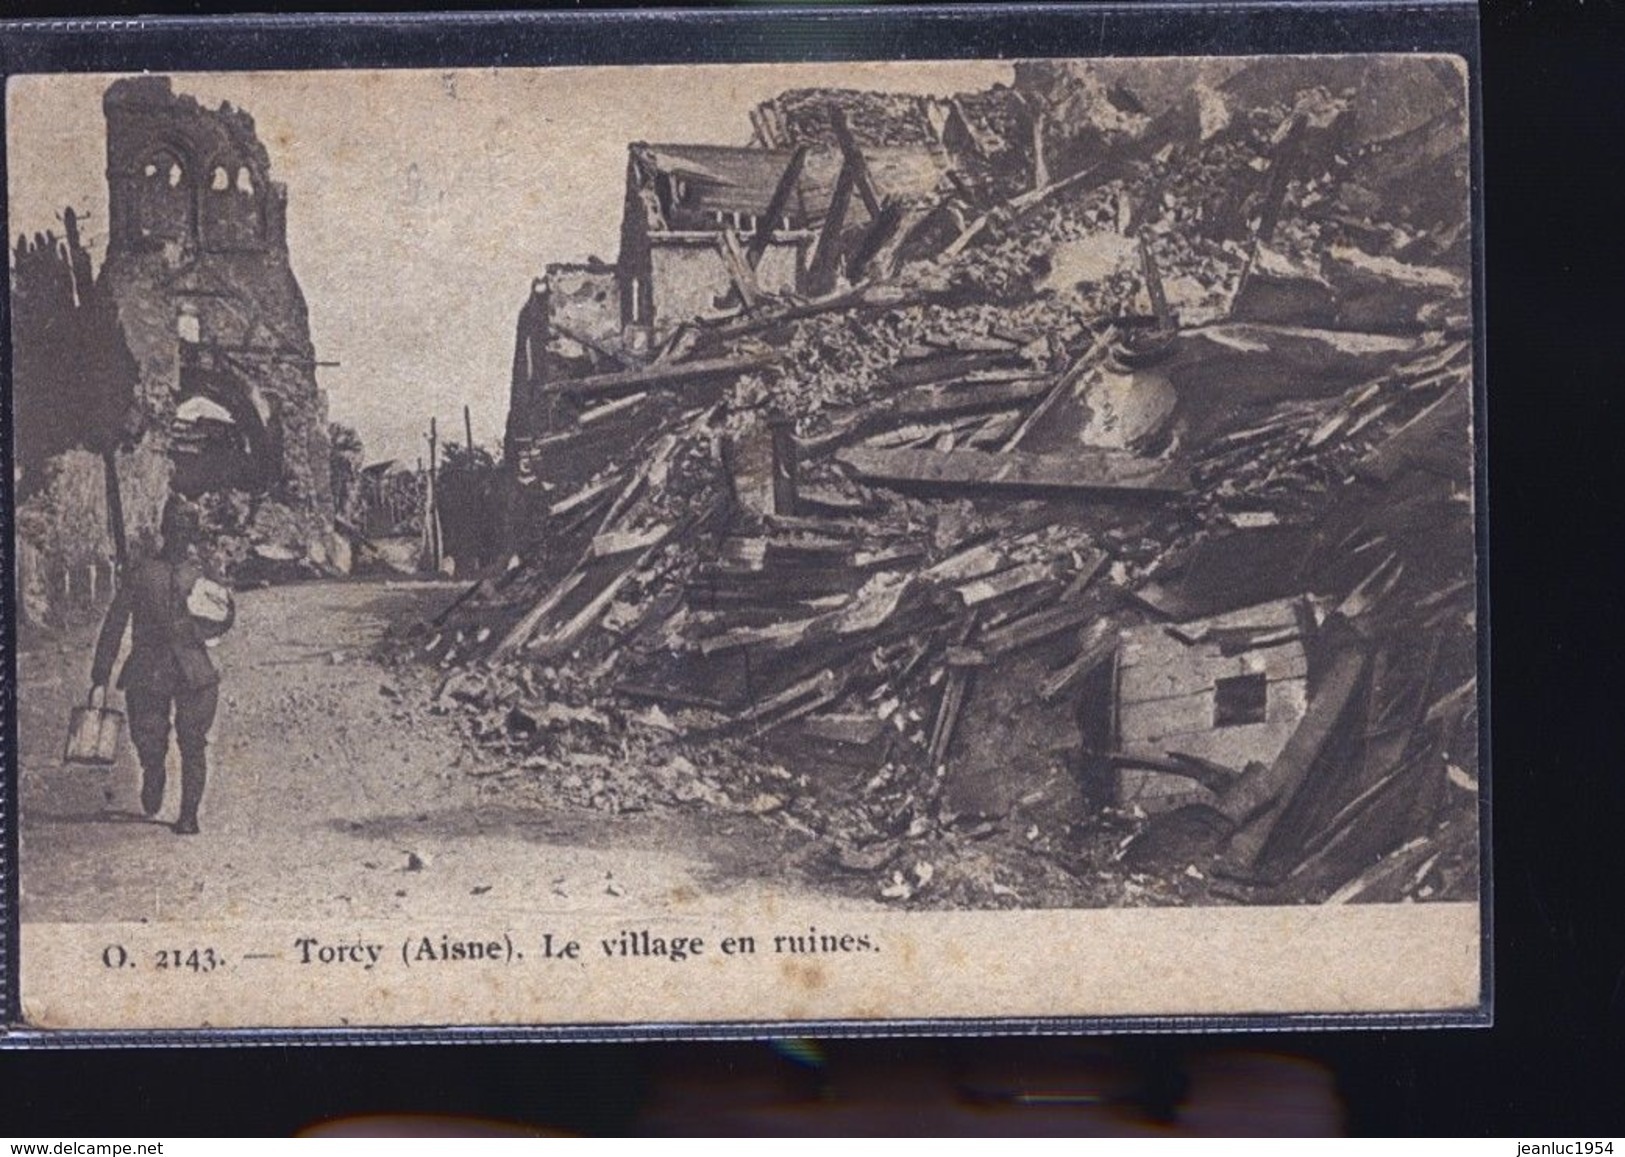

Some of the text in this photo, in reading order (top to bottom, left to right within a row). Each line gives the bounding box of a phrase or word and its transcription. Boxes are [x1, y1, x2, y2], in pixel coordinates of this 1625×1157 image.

[102, 944, 136, 969] O.
[155, 948, 226, 973] 2143.
[294, 937, 383, 970] Torcy
[402, 934, 524, 966] (Aisne).
[542, 933, 581, 959] Le
[601, 930, 705, 962] village
[720, 936, 756, 955] en
[774, 926, 881, 954] ruines.
